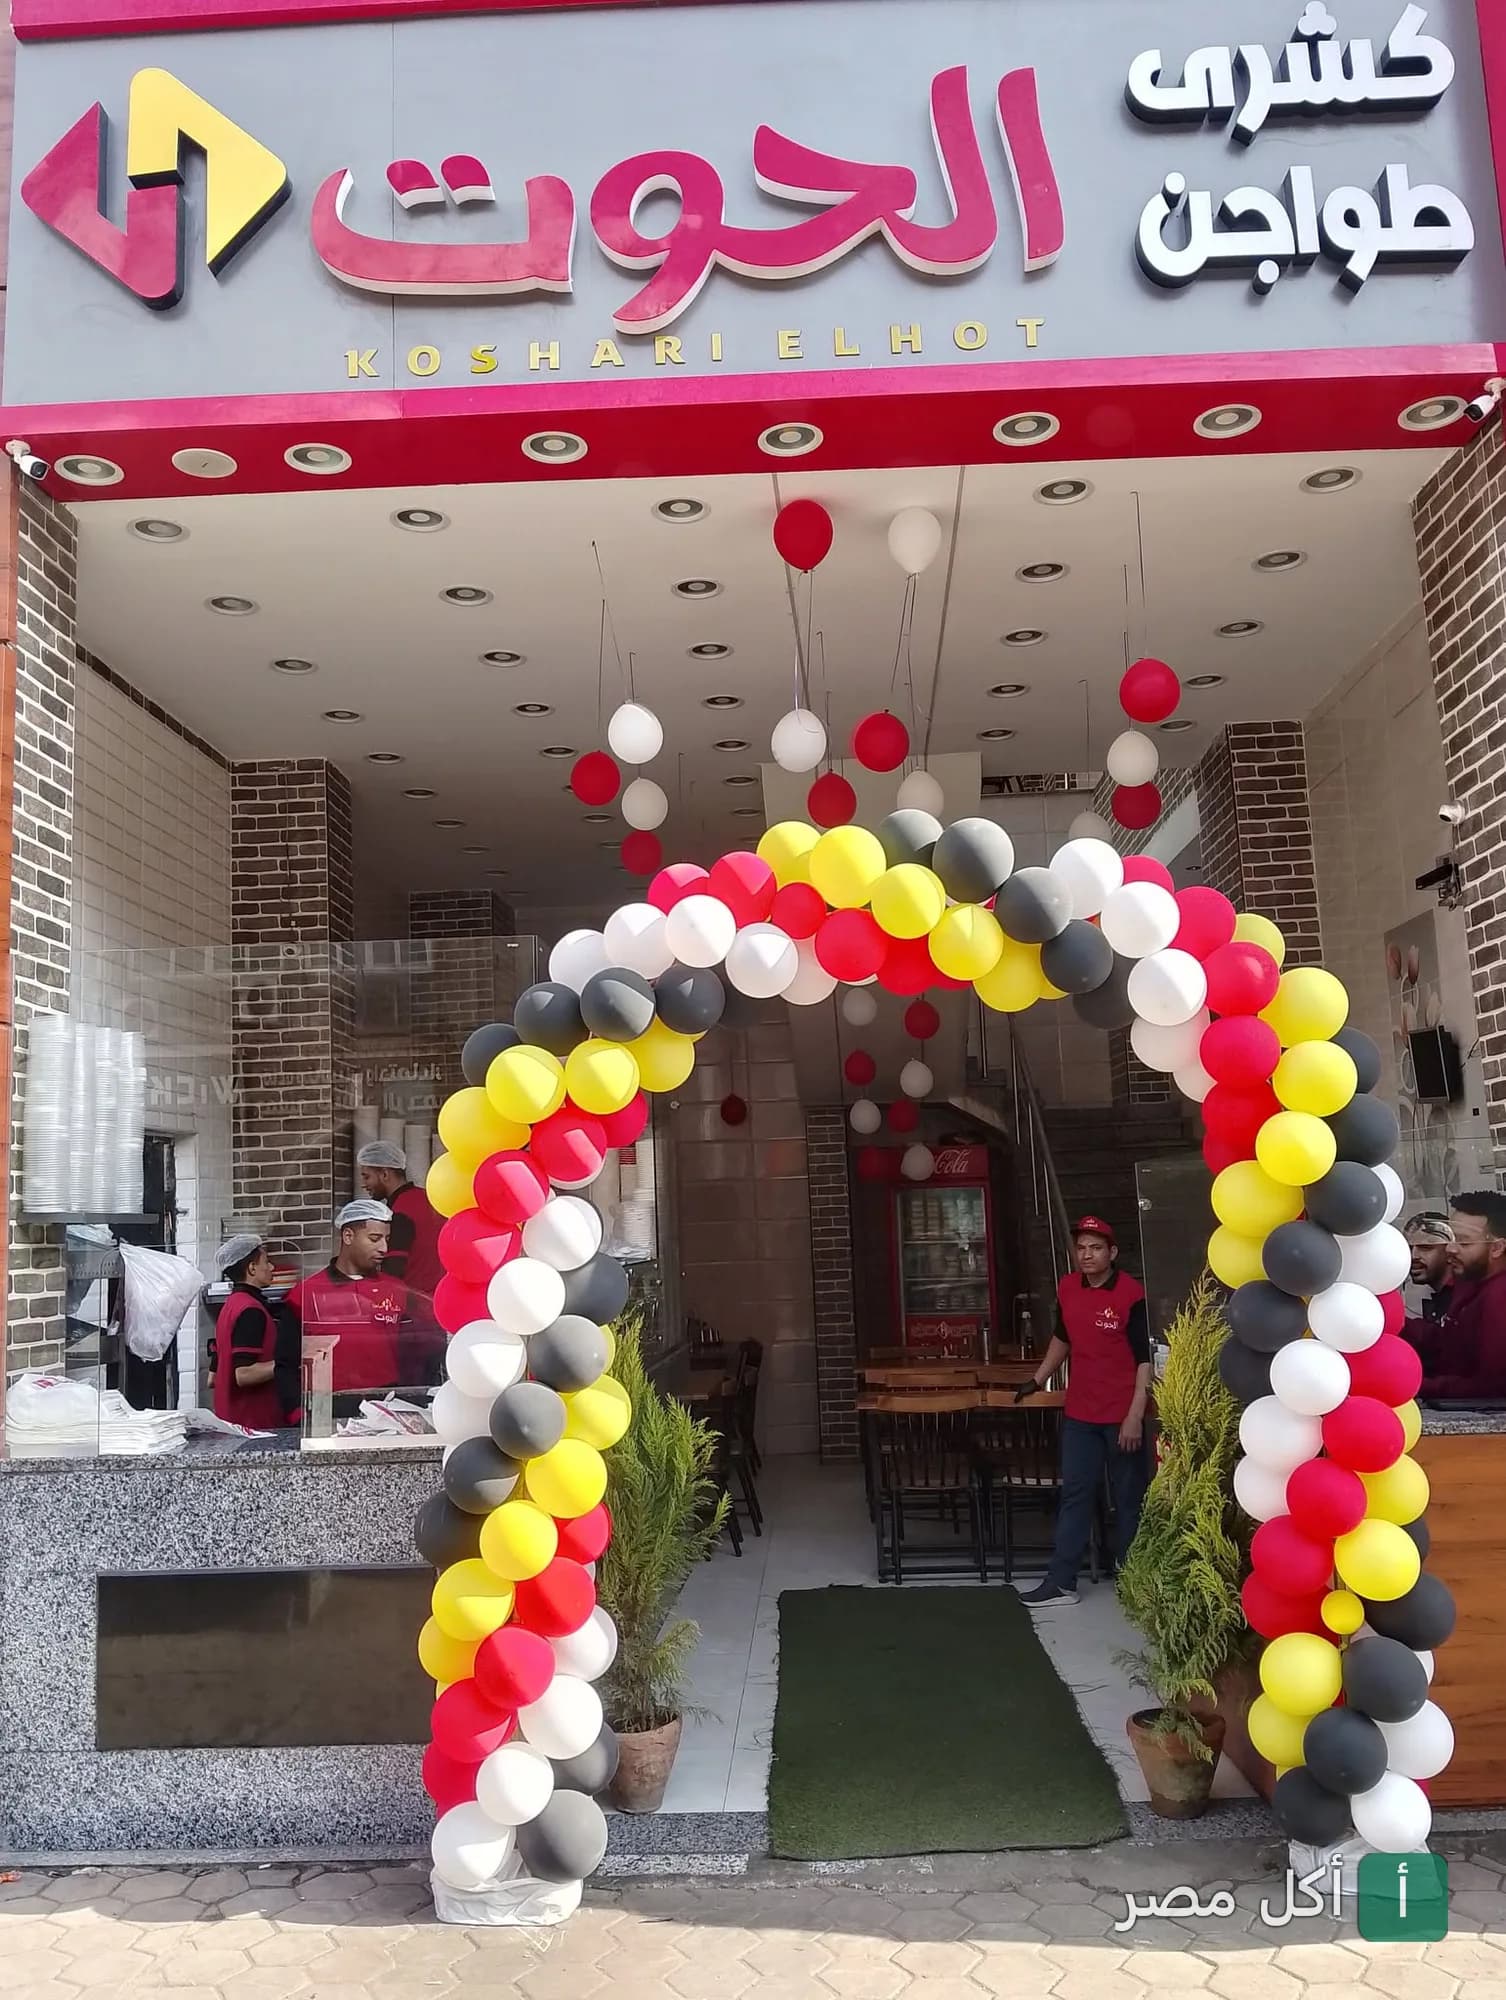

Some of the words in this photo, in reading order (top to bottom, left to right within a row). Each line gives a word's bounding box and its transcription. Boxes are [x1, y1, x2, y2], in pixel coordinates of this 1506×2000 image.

[311, 65, 1065, 334] الحوت
[1136, 163, 1475, 293] طواجن
[346, 333, 723, 379] KOSHARI
[777, 317, 1045, 360] ELHOT
